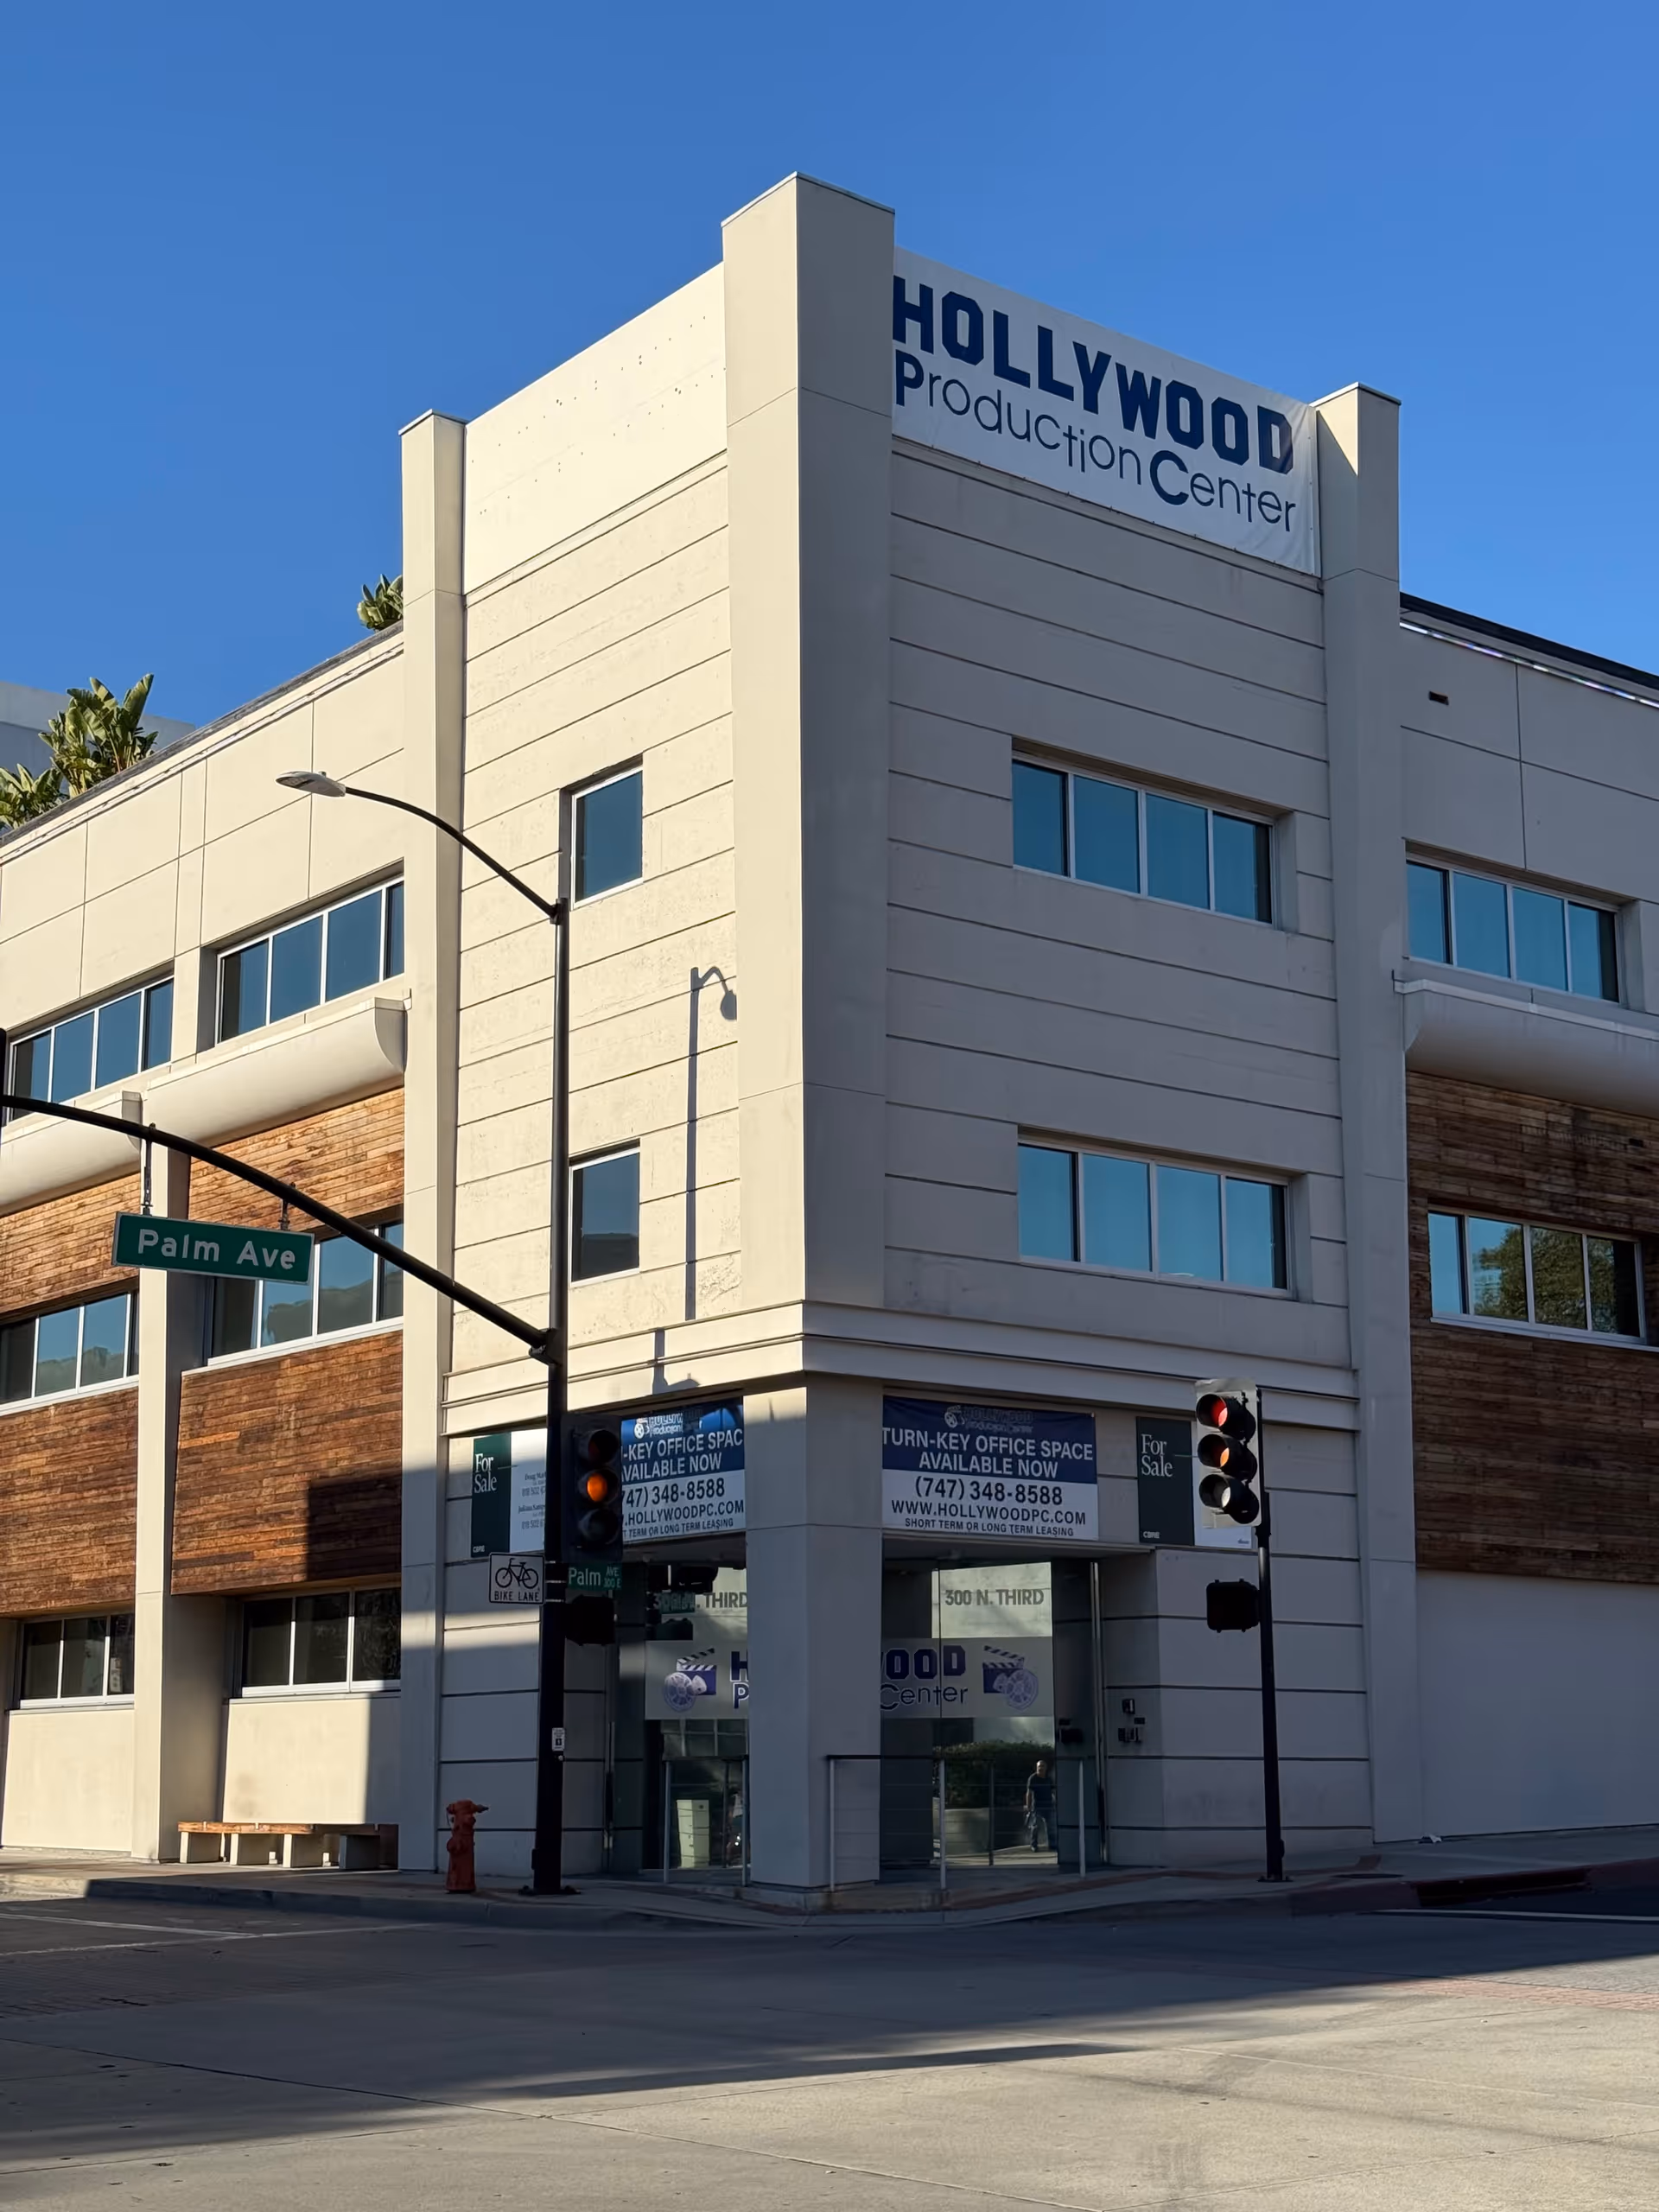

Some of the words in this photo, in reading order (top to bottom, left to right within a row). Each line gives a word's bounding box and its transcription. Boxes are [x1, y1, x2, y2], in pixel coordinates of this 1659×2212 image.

[893, 275, 1293, 475] HOLLYWOOD
[138, 1229, 219, 1262] Palm
[236, 1241, 296, 1270] Ave
[621, 1441, 653, 1462] -KEY
[657, 1433, 704, 1457] OFFICE
[881, 1427, 970, 1452] TURN-KEY
[975, 1435, 1036, 1457] OFFICE
[1040, 1440, 1093, 1460] SPACE
[1141, 1433, 1167, 1456] For
[475, 1453, 494, 1472] For
[690, 1452, 722, 1473] NOW
[918, 1451, 1014, 1475] AVAILABLE
[1018, 1459, 1058, 1478] NOW
[1141, 1453, 1173, 1478] Sale
[474, 1471, 497, 1494] Sale
[652, 1477, 725, 1505] 348-8588
[916, 1476, 965, 1501] (747)
[969, 1480, 1063, 1506] 348-8588
[621, 1499, 744, 1528] .HOLLYWOODPC.COM
[892, 1499, 1086, 1525] WWW.HOLLYWOODPC.COM
[629, 1527, 647, 1538] TERM
[649, 1525, 658, 1536] OR
[660, 1523, 679, 1535] LONG
[682, 1522, 701, 1533] TERM
[702, 1518, 734, 1530] LEASING
[905, 1517, 936, 1529] SHORT
[938, 1519, 963, 1530] TERM
[966, 1522, 979, 1531] OR
[982, 1522, 1007, 1533] LONG
[1009, 1523, 1033, 1535] TERM
[1035, 1525, 1074, 1536] LEASING
[568, 1567, 601, 1586] Palm
[606, 1566, 620, 1577] AVE
[494, 1590, 513, 1601] BIKE
[518, 1591, 540, 1602] LANE
[704, 1591, 747, 1608] THIRD
[976, 1589, 994, 1605] N.
[995, 1588, 1044, 1605] THIRD
[880, 1644, 966, 1680] OOD
[880, 1682, 969, 1711] Center
